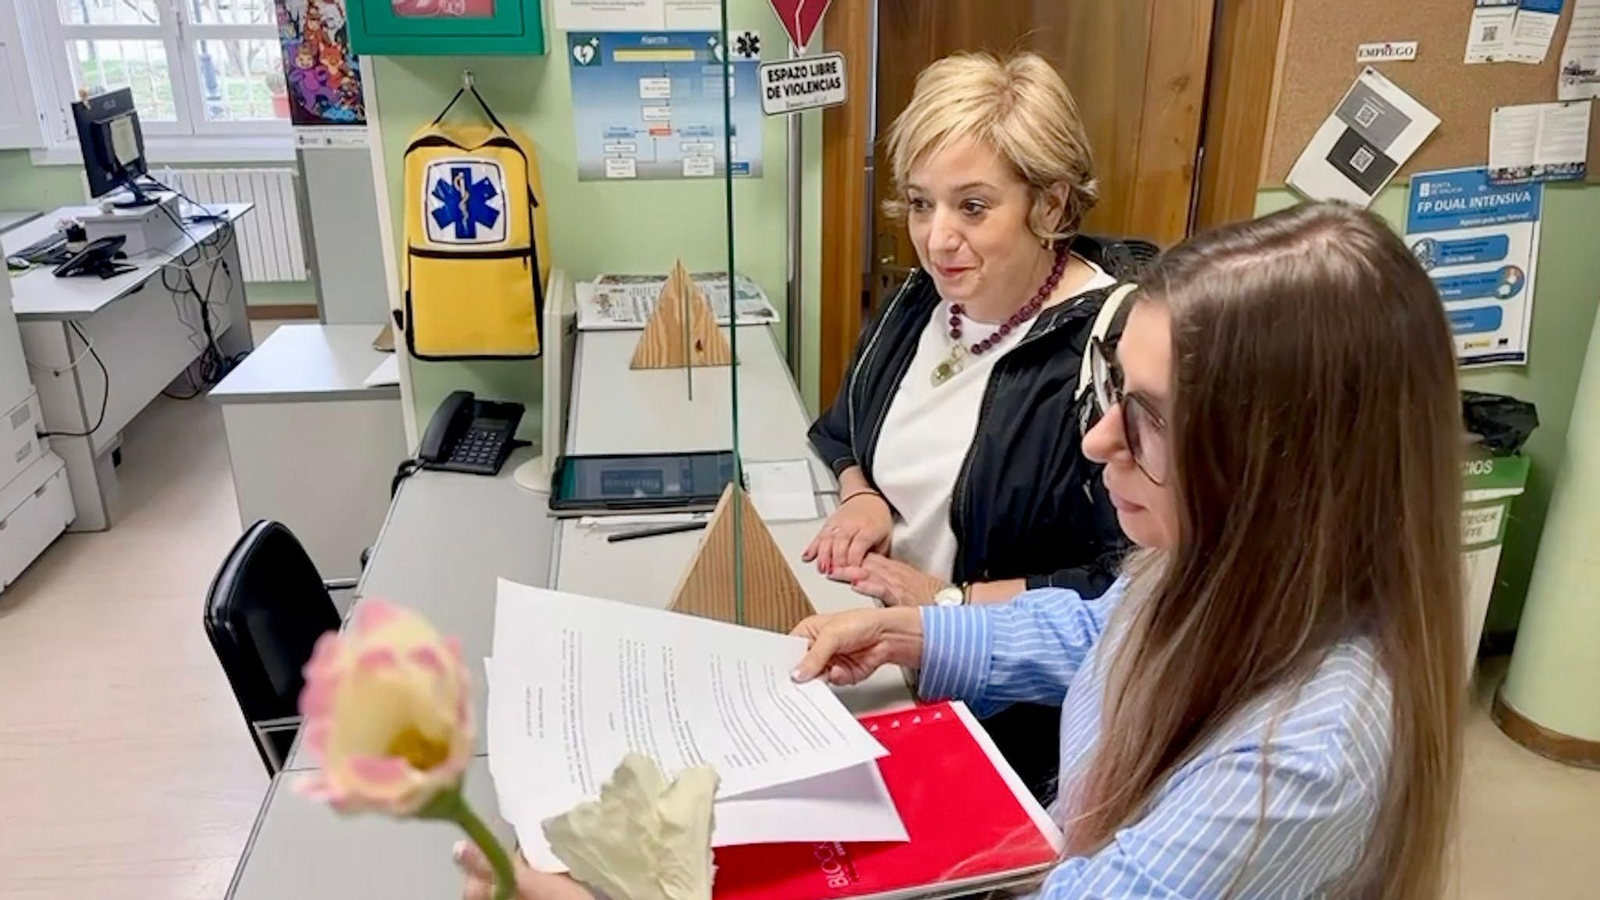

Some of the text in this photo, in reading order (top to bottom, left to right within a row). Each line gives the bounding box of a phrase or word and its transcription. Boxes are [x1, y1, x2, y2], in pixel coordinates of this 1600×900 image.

[1359, 46, 1413, 58] EMPREGO
[767, 61, 837, 83] ESPAZO LIBRE
[767, 77, 841, 99] DE VIOLENCIAS
[1417, 201, 1432, 213] FP
[1434, 198, 1467, 212] DUAL
[1469, 191, 1532, 209] INTENSIVA
